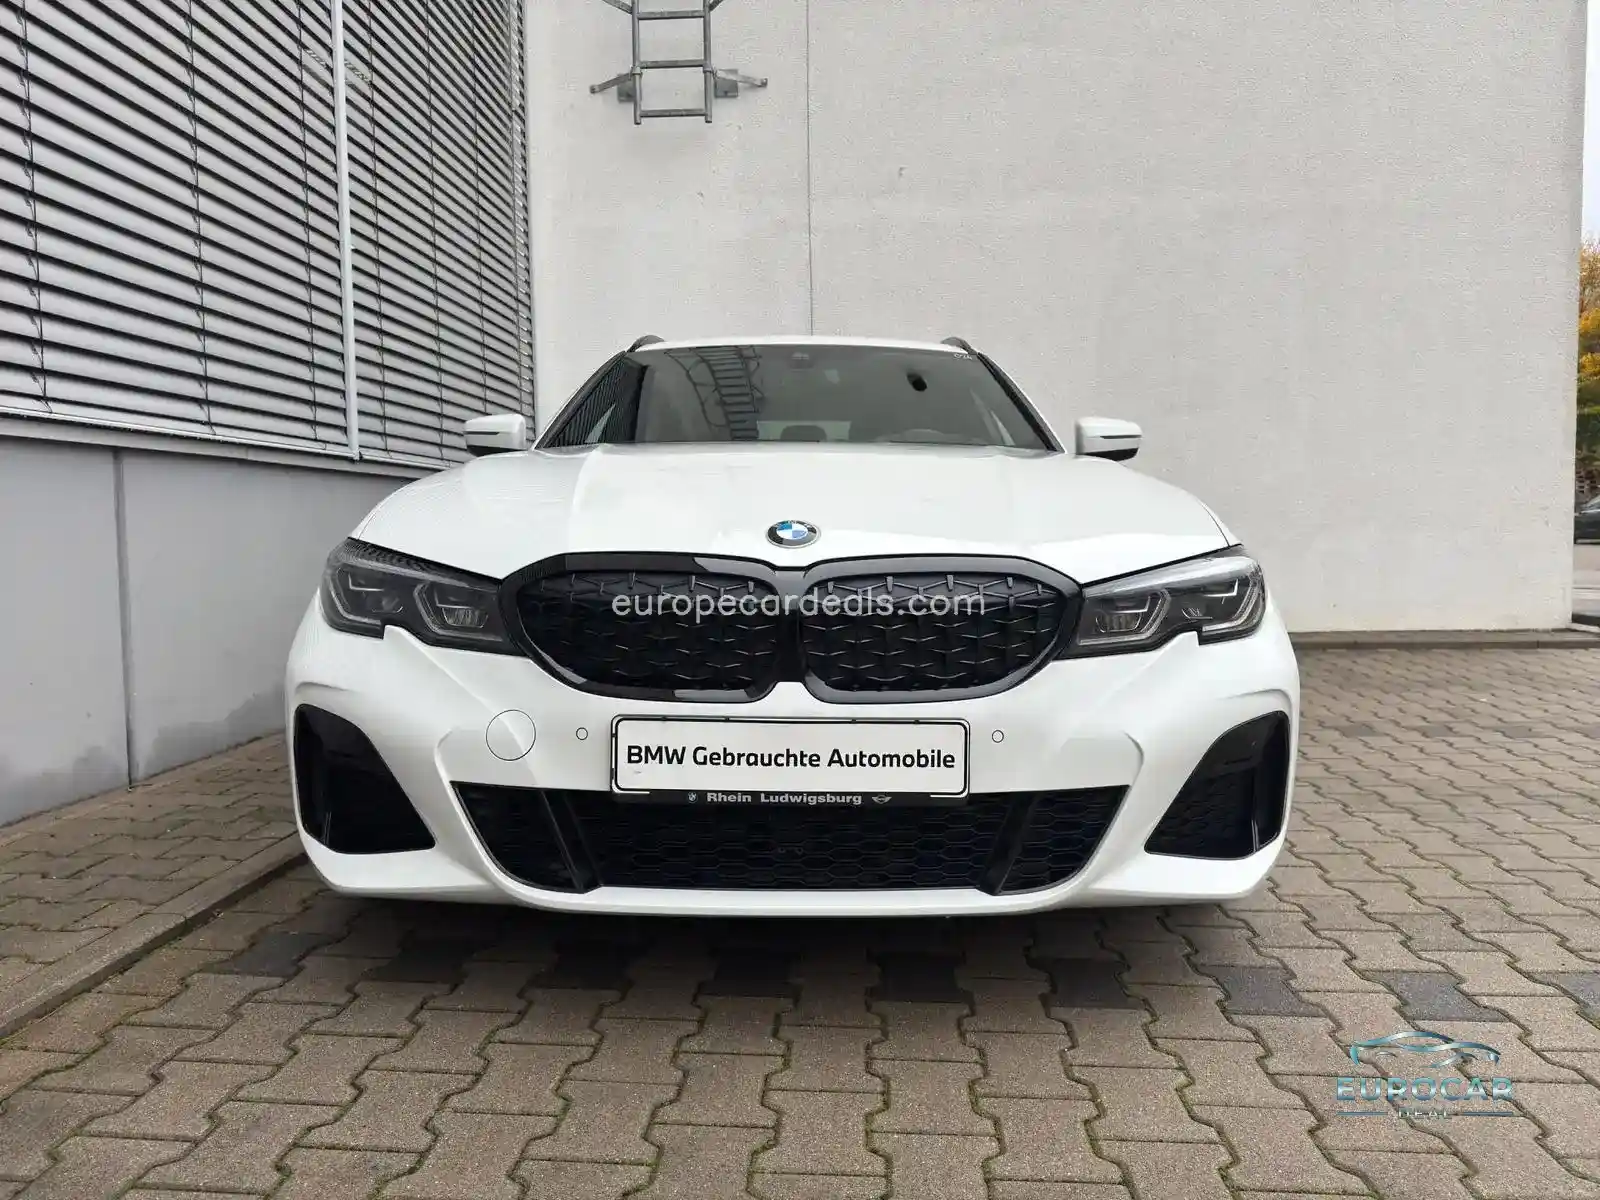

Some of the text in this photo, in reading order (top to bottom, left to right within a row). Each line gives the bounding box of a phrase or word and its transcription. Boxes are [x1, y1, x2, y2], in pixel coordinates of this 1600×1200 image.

[626, 745, 956, 769] BMW Gebrauchte Automobile
[706, 792, 752, 803] Rhein
[760, 792, 863, 806] Ludwigsburg
